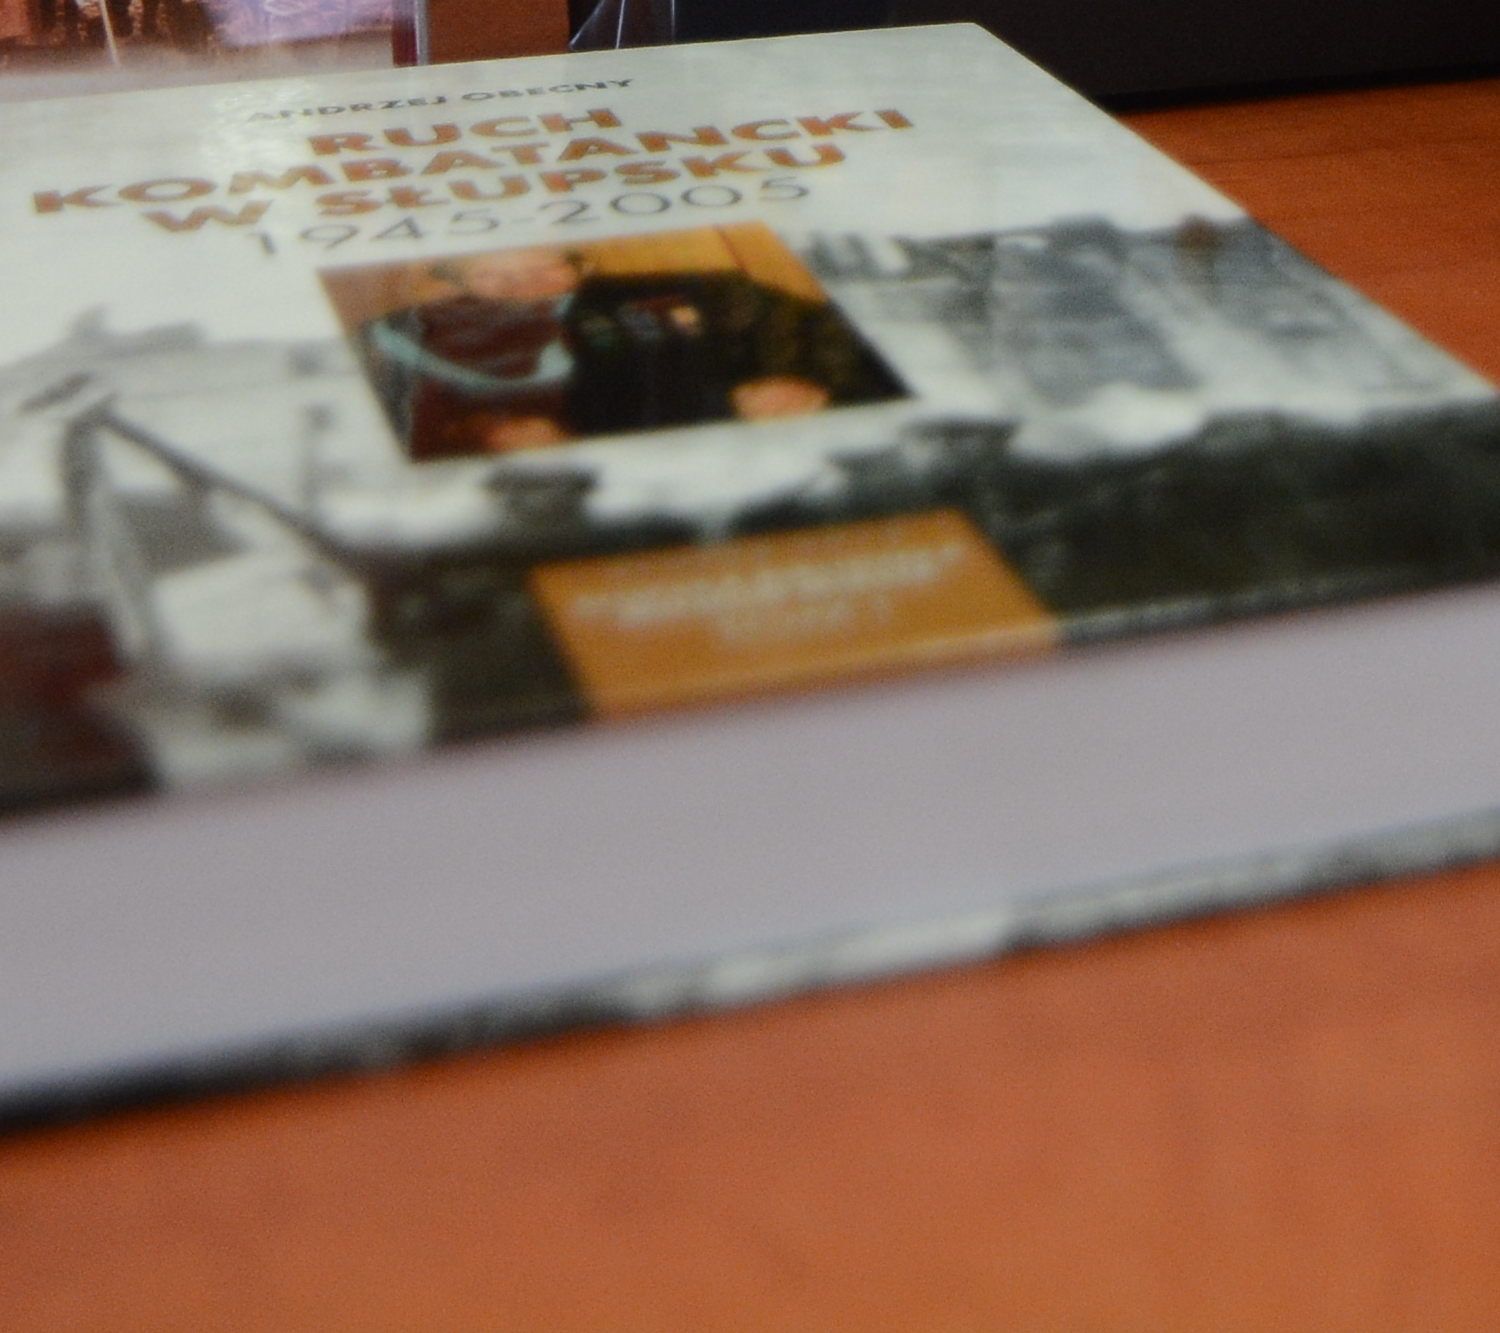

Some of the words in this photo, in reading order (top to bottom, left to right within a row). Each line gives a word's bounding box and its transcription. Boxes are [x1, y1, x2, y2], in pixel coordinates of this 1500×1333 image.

[32, 107, 916, 216] KOMBATANCKI
[308, 106, 621, 158] RUCH
[245, 175, 815, 259] 1945-2005
